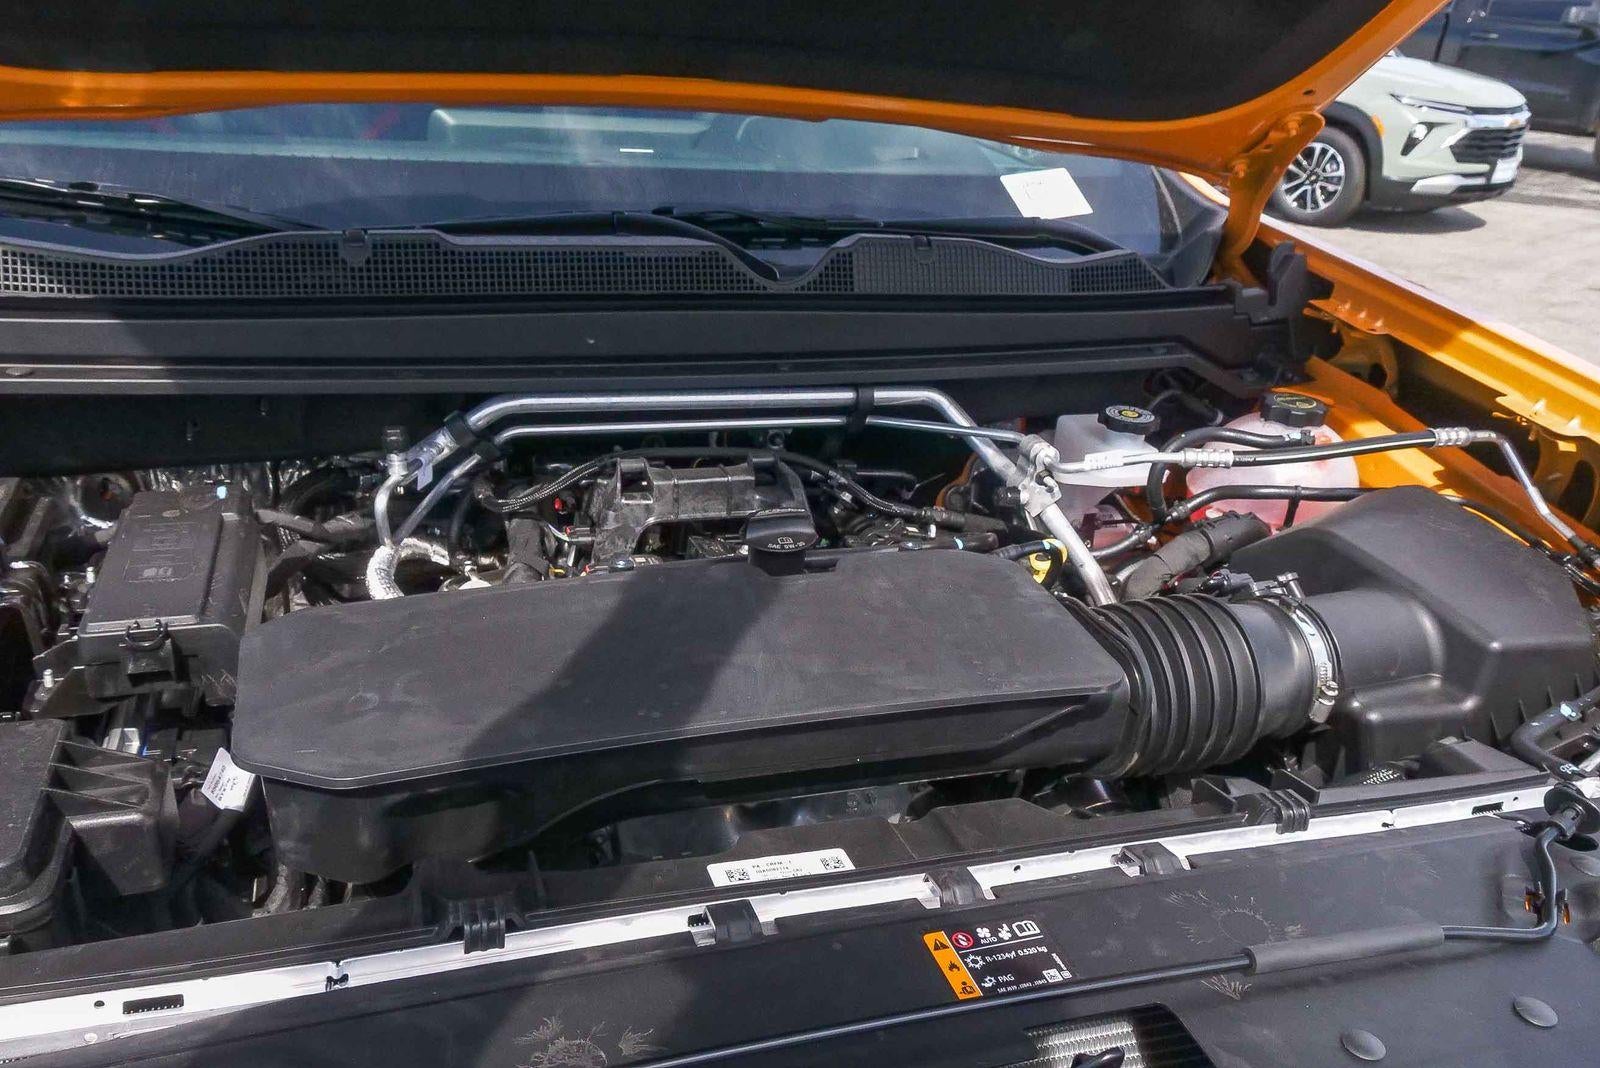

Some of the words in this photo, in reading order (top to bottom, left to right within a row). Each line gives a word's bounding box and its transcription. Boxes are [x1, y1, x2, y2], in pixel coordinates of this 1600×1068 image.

[985, 951, 1016, 962] R-1234yf
[1018, 947, 1037, 956] 0.520
[1037, 945, 1048, 953] kg
[998, 974, 1015, 983] PAG
